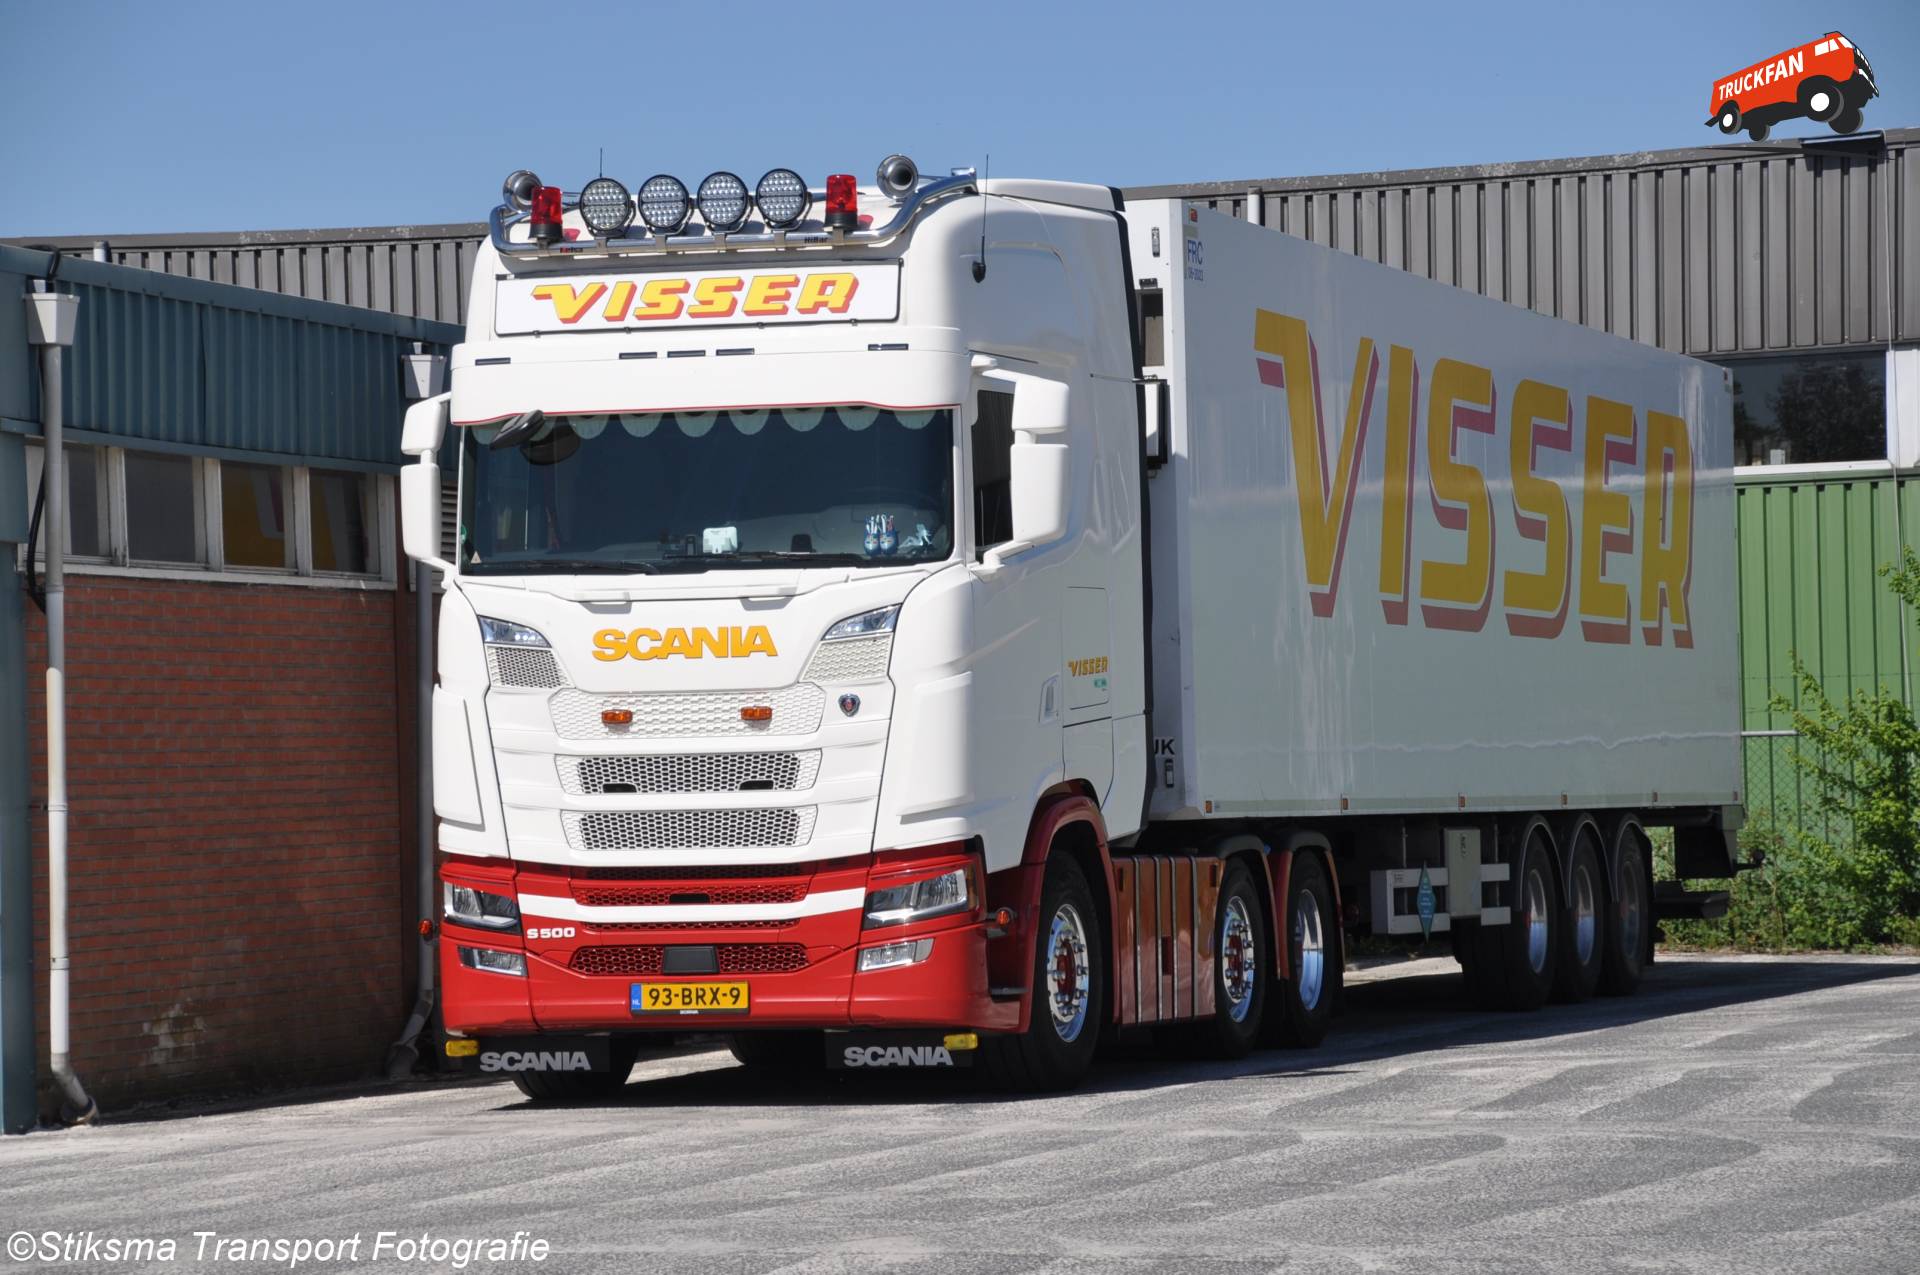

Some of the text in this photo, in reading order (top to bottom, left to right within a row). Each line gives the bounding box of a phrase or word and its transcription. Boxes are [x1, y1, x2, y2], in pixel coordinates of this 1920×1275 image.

[1187, 239, 1203, 265] FRC
[532, 272, 859, 323] VISSER
[1254, 308, 1694, 649] VISSER
[592, 625, 778, 662] SCANIA
[649, 986, 741, 1007] 93-BRX-9
[479, 1051, 592, 1072] SCANIA
[844, 1046, 954, 1067] SCANIA
